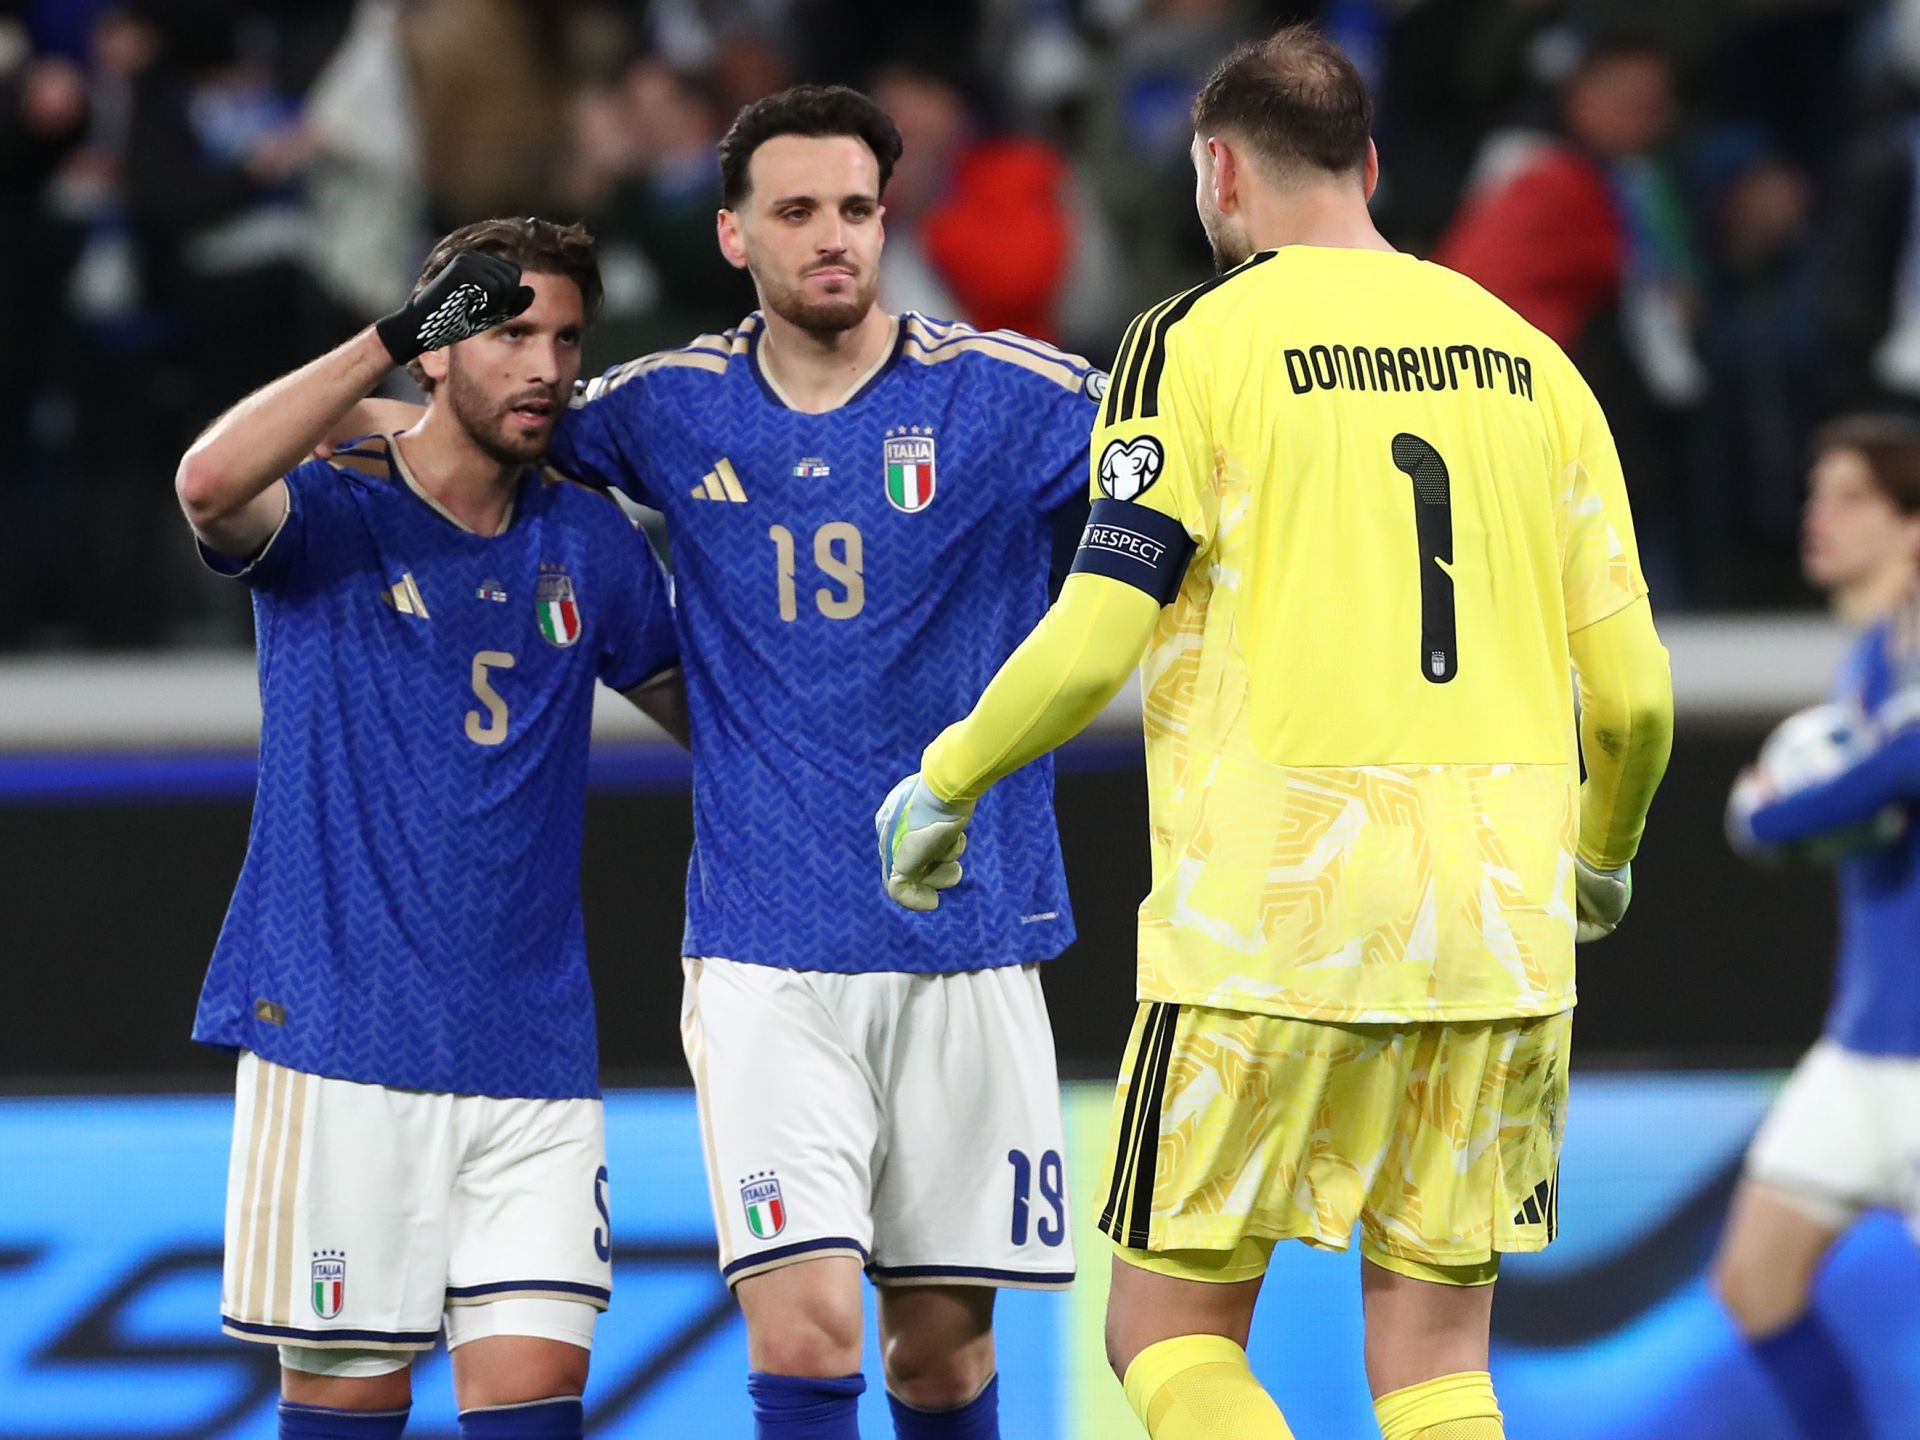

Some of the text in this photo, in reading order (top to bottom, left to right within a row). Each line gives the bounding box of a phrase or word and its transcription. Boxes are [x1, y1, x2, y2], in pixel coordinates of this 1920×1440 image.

[1284, 345, 1533, 401] DONNARUMMA
[888, 443, 931, 459] ITALIA
[769, 521, 865, 622] 19
[1090, 528, 1164, 562] RESPECT
[1391, 432, 1458, 684] 1
[464, 650, 515, 745] 5
[744, 1183, 777, 1201] ITALIA
[1008, 1149, 1065, 1247] 19
[313, 1264, 342, 1276] ITALIA
